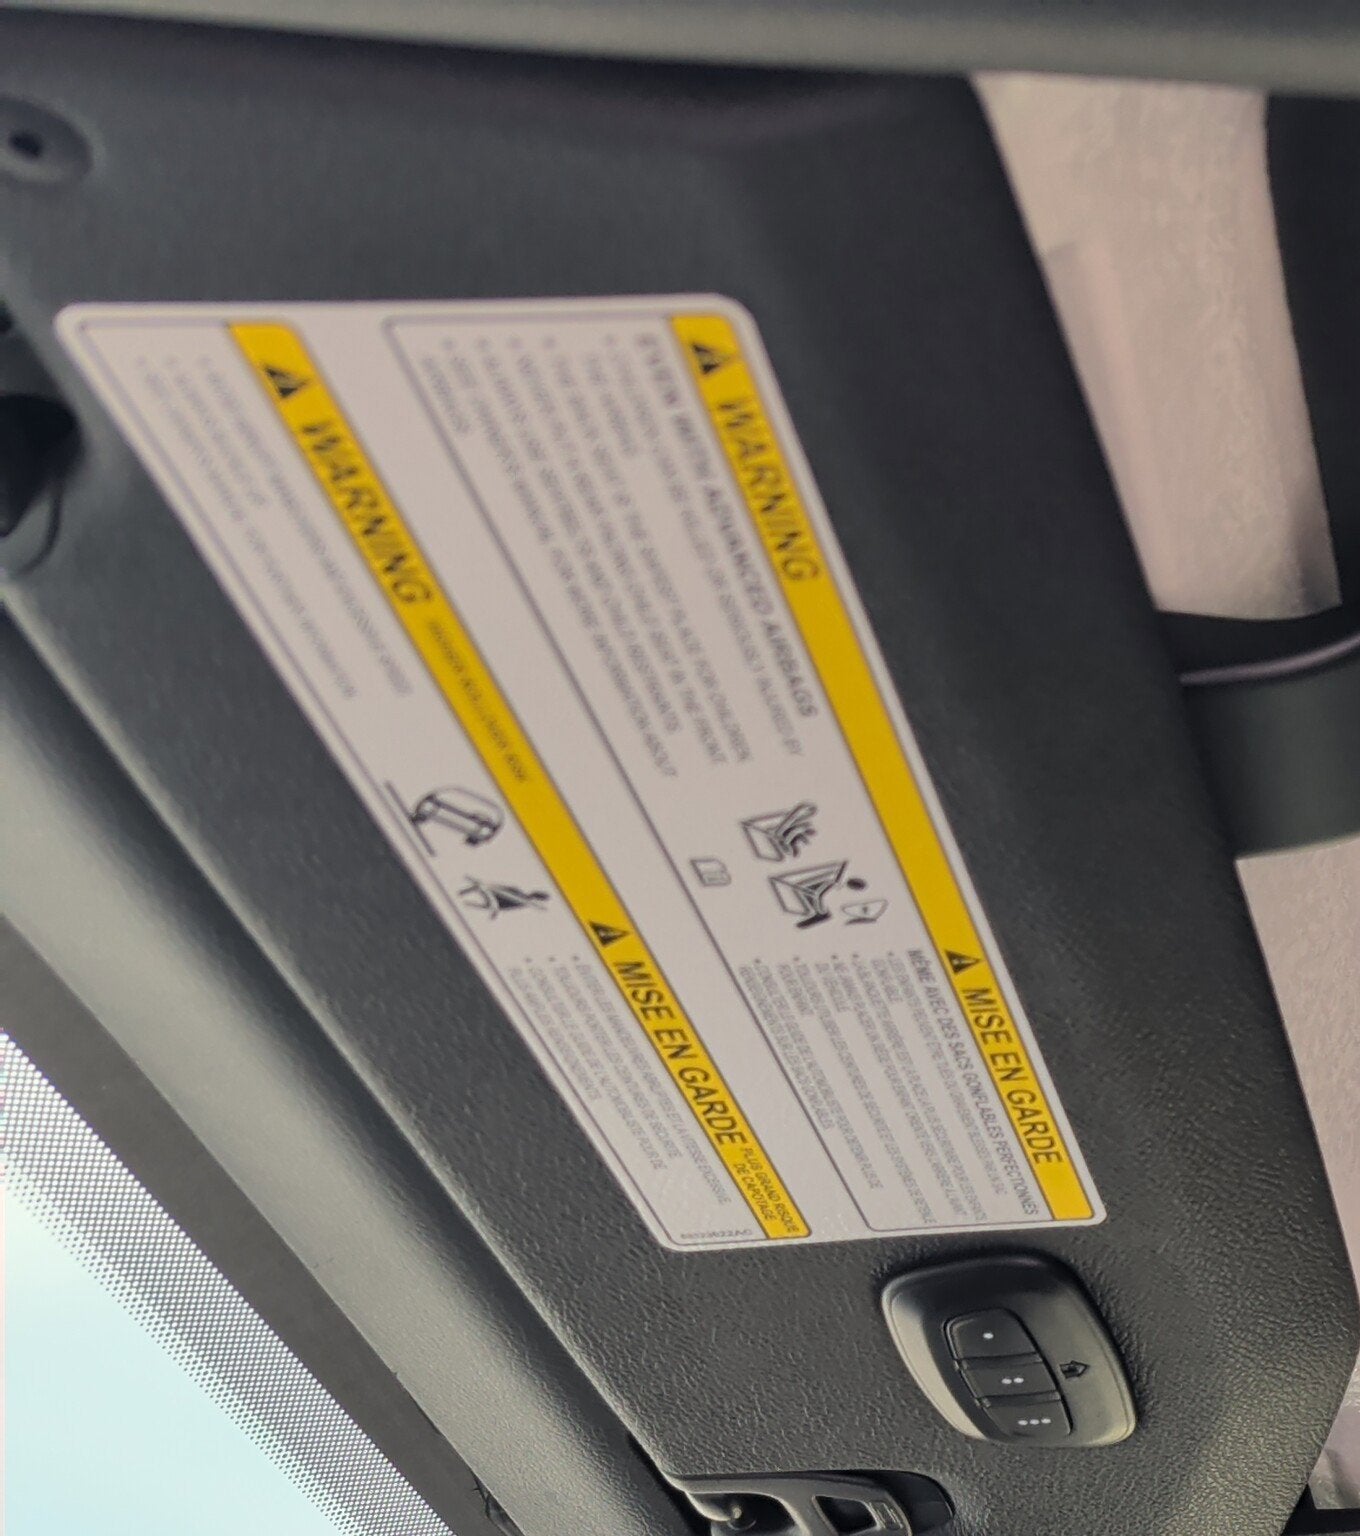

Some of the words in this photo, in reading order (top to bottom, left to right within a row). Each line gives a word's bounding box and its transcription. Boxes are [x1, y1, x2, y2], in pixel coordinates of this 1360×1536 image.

[292, 421, 438, 603] WARNING
[710, 399, 824, 580] WARNING
[631, 334, 686, 406] EVEN
[667, 415, 717, 478] WITH
[699, 486, 777, 616] ADVANCED
[760, 623, 822, 717] AIRBAGS
[612, 960, 676, 1020] MISE
[922, 986, 951, 1015] AVEC
[960, 987, 1014, 1045] MISE
[652, 1028, 699, 1059] EN
[936, 1018, 961, 1039] DES
[947, 1042, 975, 1069] SACS
[988, 1051, 1029, 1081] EN
[674, 1066, 748, 1145] GARDE
[960, 1072, 1004, 1136] GONFLABLES
[1004, 1088, 1064, 1164] GARDE
[732, 1163, 750, 1174] DE
[739, 1147, 764, 1170] PLUS
[753, 1171, 782, 1202] GRAND
[771, 1203, 800, 1232] RISQUE
[740, 1176, 777, 1220] CAPOTAGE
